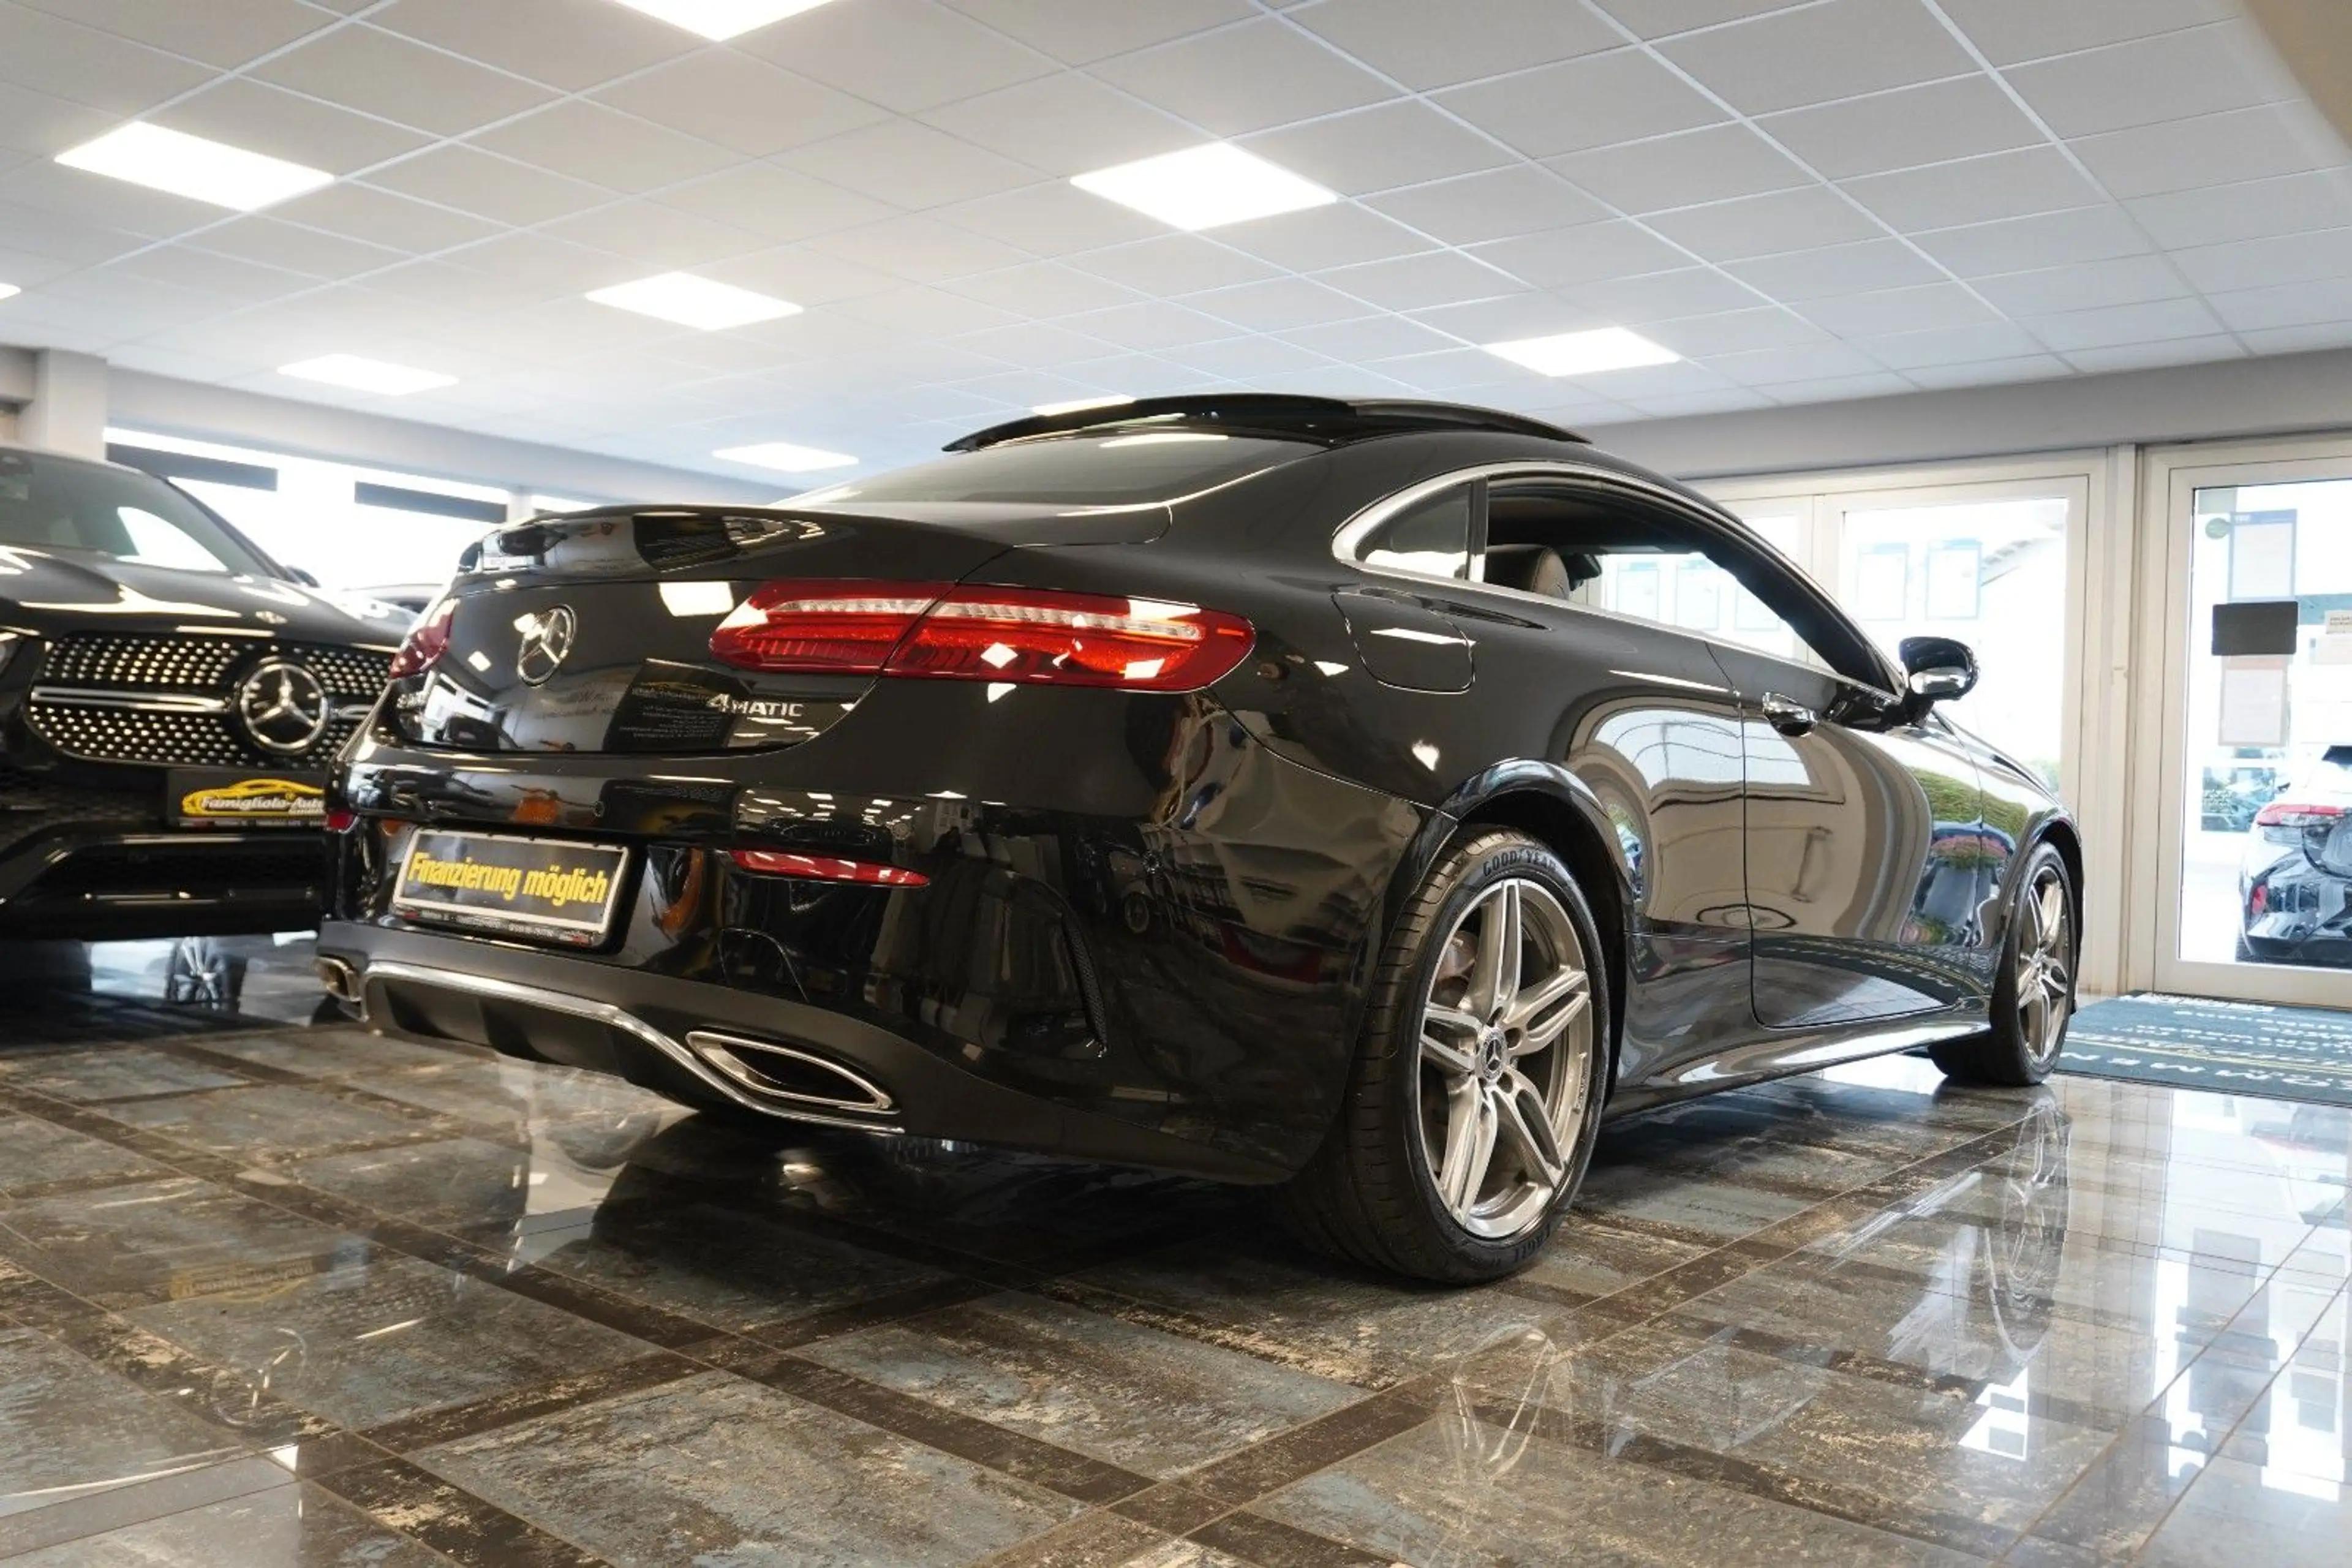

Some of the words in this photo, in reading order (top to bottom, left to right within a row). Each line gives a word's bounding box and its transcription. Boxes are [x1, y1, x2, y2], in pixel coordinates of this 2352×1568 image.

[706, 693, 805, 717] 4MATIC
[407, 852, 522, 900] Finanzierung
[522, 865, 608, 906] möglich
